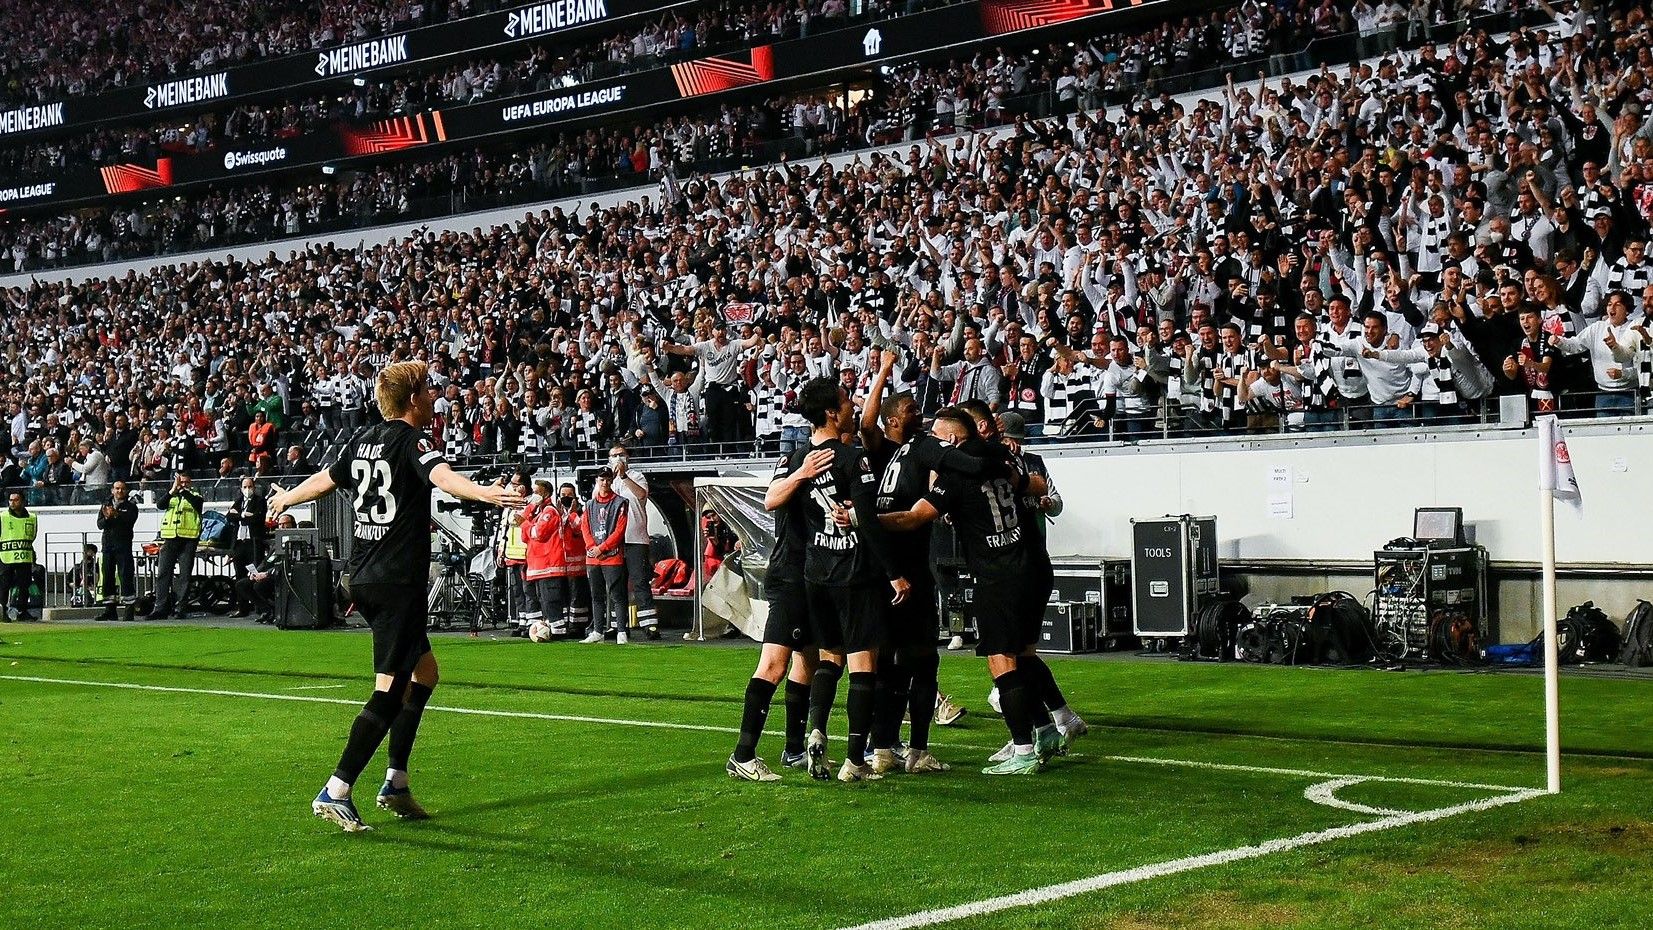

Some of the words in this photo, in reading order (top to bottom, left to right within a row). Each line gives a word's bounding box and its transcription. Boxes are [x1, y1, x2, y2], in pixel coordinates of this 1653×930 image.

[502, 103, 532, 121] UEFA
[533, 96, 576, 116] EUROPA
[235, 146, 286, 168] Swissquote
[351, 460, 396, 523] 23
[1144, 547, 1172, 558] TOOLS
